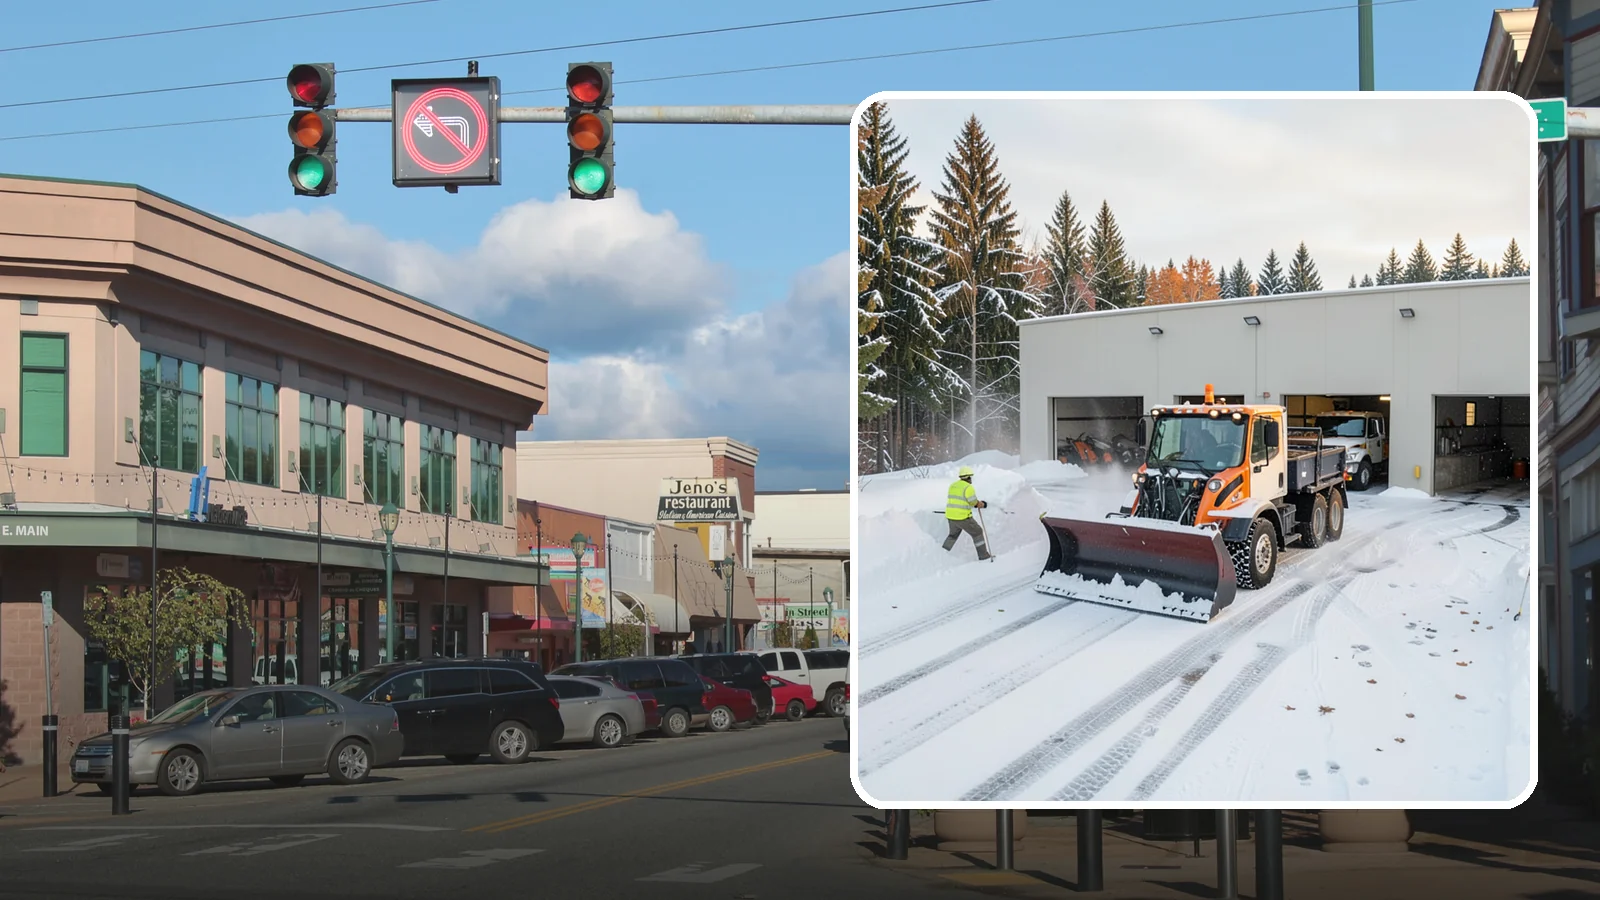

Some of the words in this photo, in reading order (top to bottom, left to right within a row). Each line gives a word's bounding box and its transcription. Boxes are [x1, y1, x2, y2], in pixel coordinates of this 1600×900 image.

[669, 480, 728, 494] Jeno's
[665, 496, 731, 509] restaurant
[686, 510, 714, 519] American
[715, 510, 737, 519] Cuisine
[2, 525, 13, 536] E.
[15, 525, 49, 536] MAIN
[797, 607, 828, 617] Street
